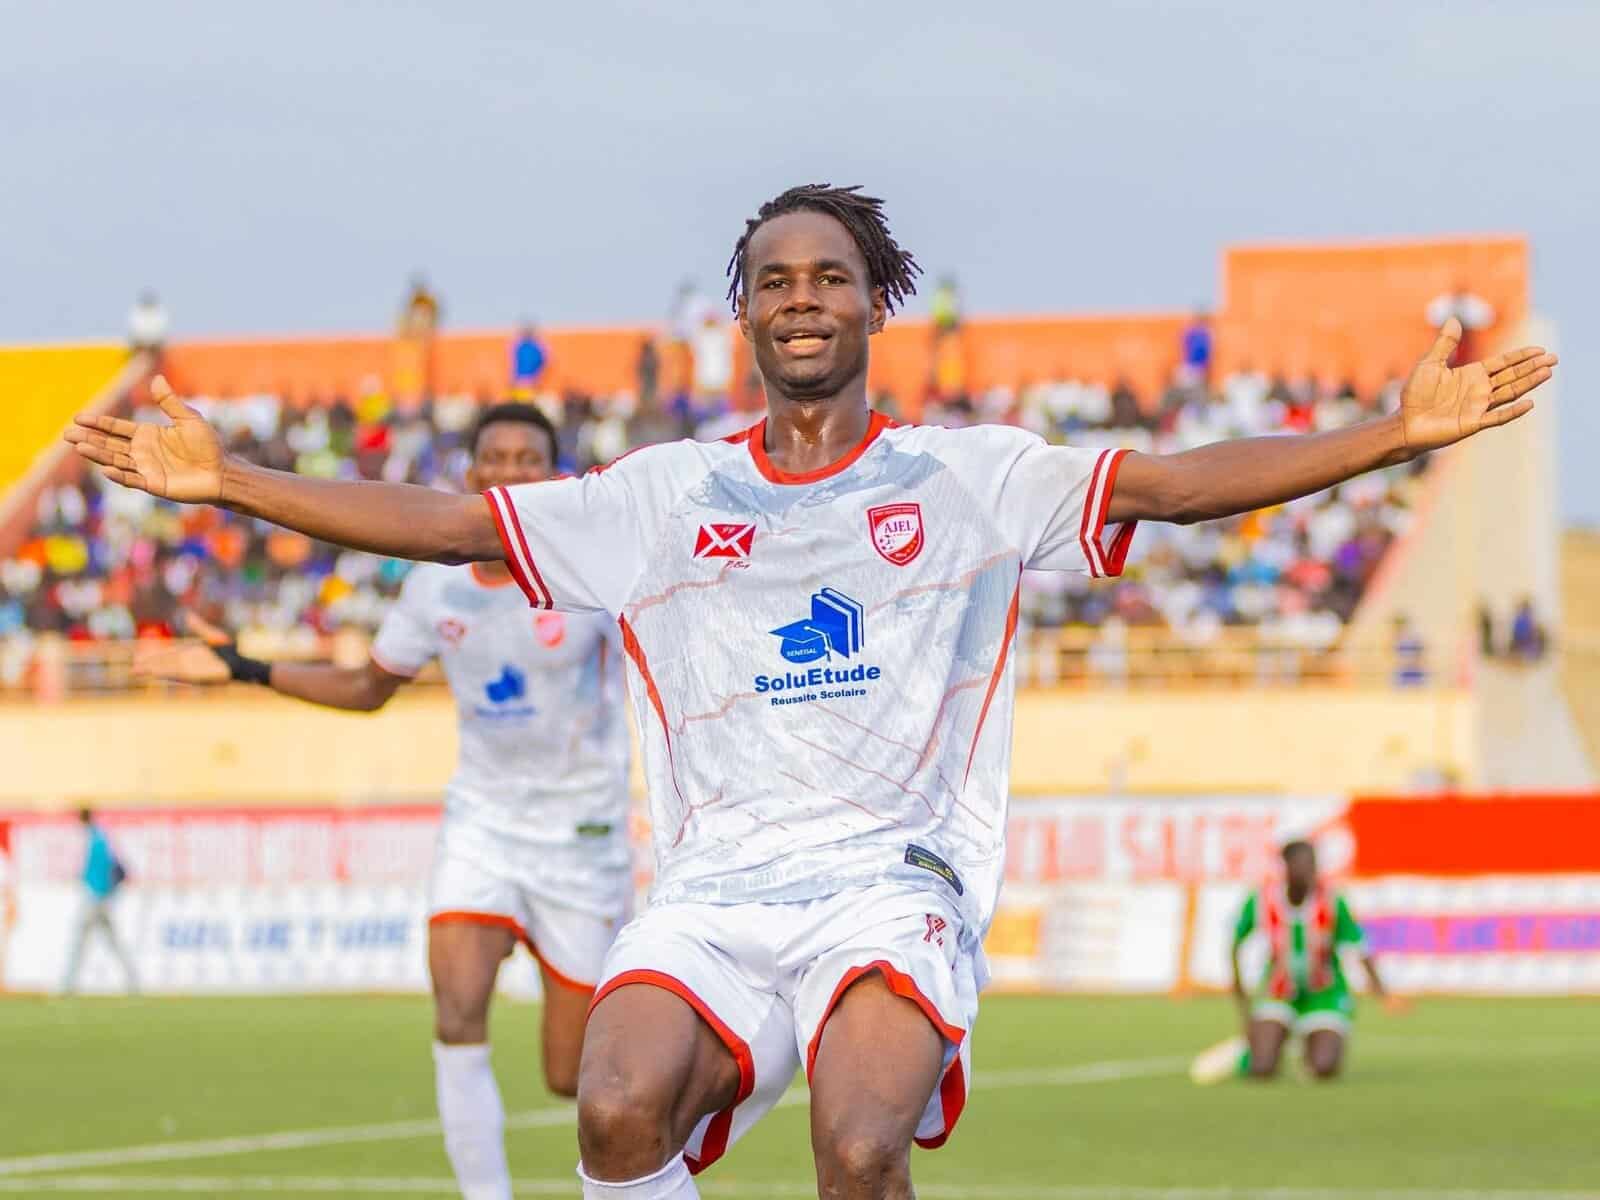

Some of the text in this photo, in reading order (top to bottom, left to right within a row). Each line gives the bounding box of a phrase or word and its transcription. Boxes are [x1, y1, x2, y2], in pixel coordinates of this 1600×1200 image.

[884, 520, 915, 533] AJEL
[755, 664, 881, 693] SoluEtude
[820, 688, 866, 699] Scolaire
